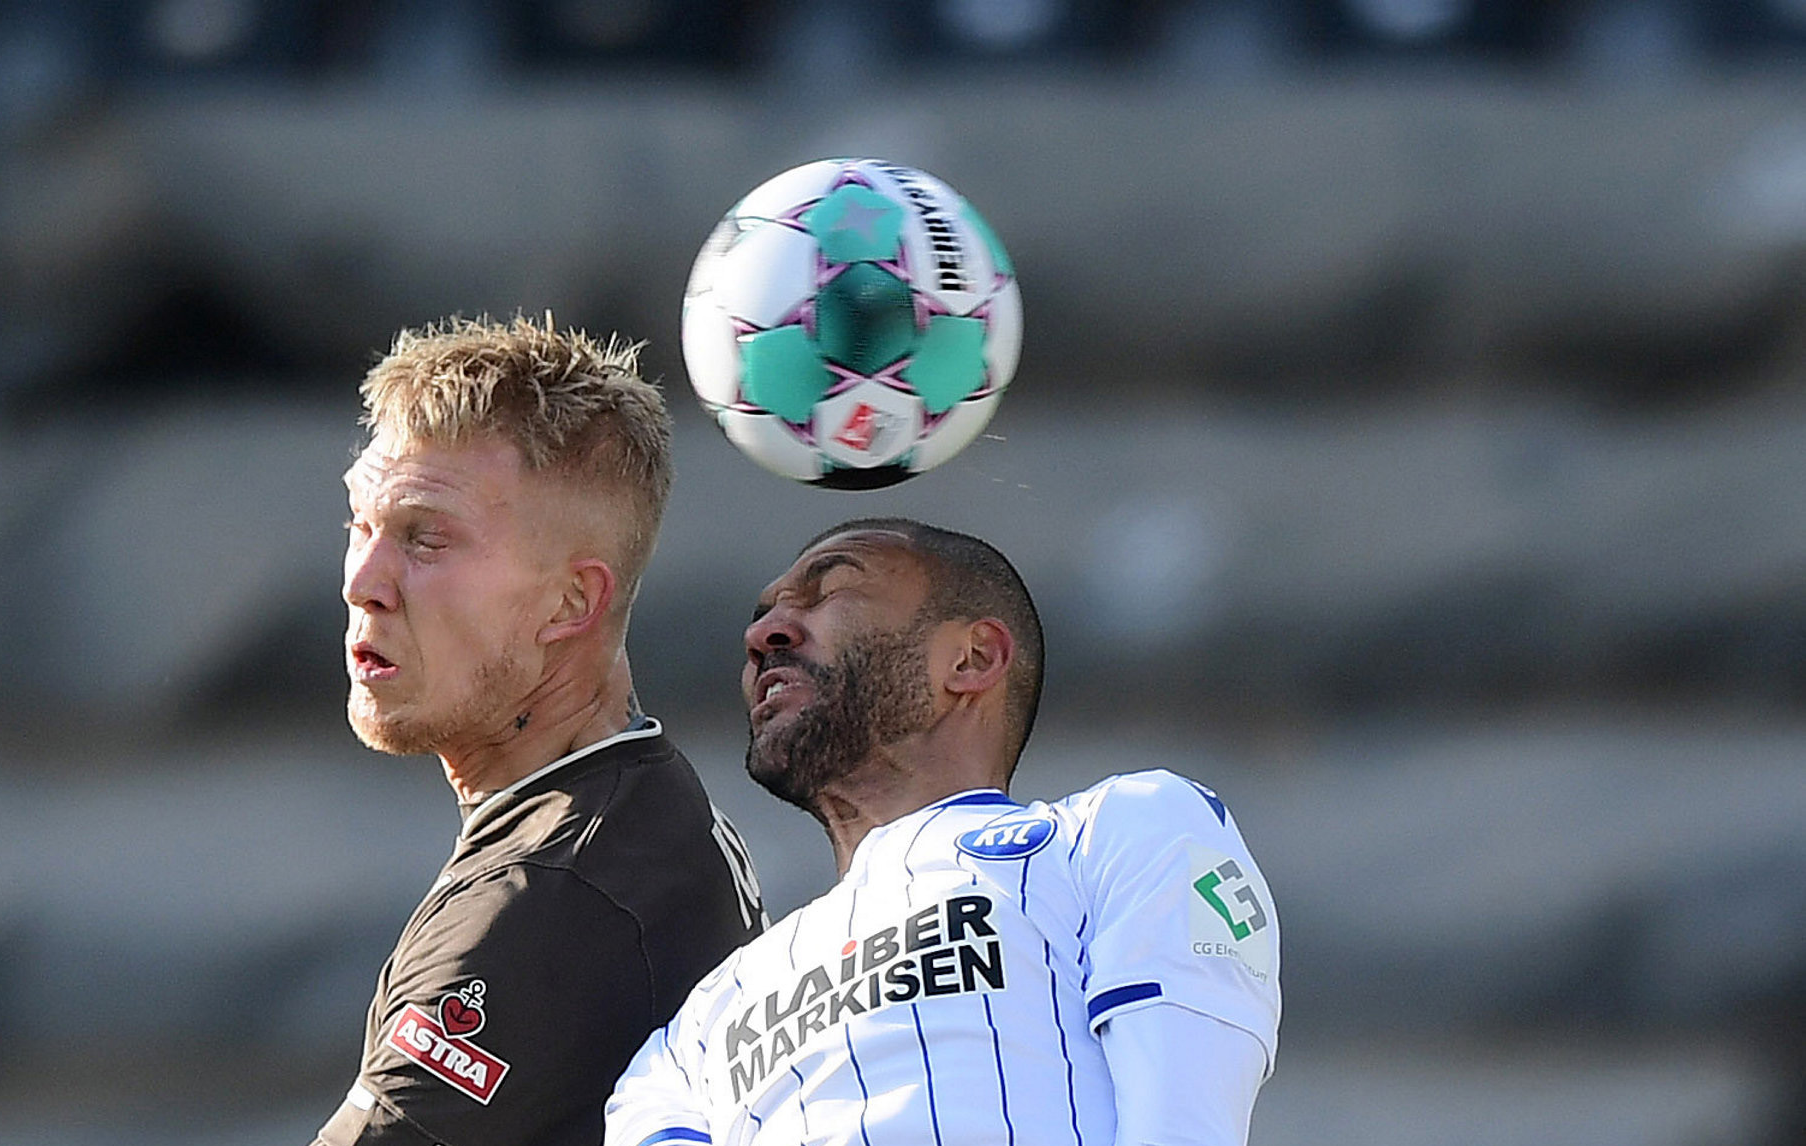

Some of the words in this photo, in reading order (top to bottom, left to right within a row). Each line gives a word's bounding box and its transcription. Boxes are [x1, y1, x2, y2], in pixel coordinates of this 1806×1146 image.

[972, 820, 1041, 847] KSC
[1193, 942, 1212, 955] CG
[729, 940, 1006, 1104] MARKISEN
[396, 1018, 489, 1090] ASTRA
